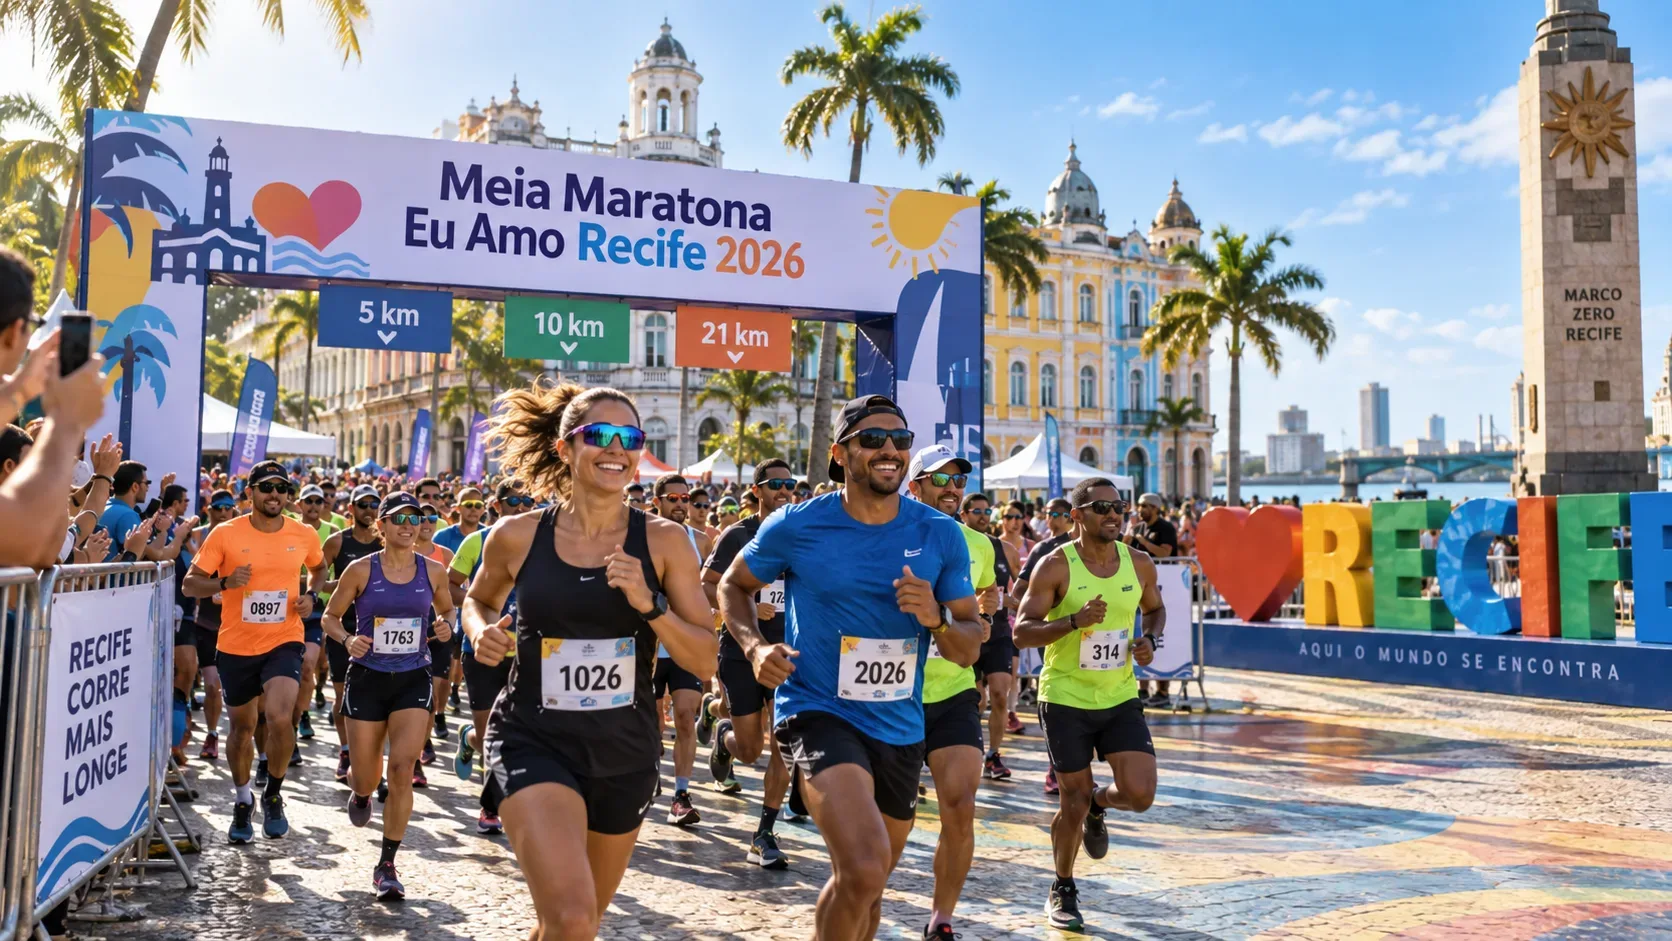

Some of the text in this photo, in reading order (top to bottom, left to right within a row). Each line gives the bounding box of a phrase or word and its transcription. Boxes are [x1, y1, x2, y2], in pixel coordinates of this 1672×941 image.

[441, 161, 772, 232] Meia Maratona
[406, 206, 806, 279] Eu Amo Recife 2026
[1565, 288, 1623, 302] MARCO
[359, 300, 420, 326] 5 km
[534, 311, 605, 338] 10 km
[1573, 307, 1616, 321] ZERO
[702, 321, 770, 348] 21 km
[1566, 327, 1623, 341] RECIFE
[250, 601, 281, 616] 0897
[69, 627, 133, 674] RECIFE
[383, 630, 414, 645] 1763
[1092, 643, 1120, 661] 314
[1299, 641, 1620, 681] AQUI O MUNDO SE ENCONTRA
[559, 663, 622, 692] 1026
[854, 660, 907, 685] 2026
[67, 664, 131, 716] CORRE
[64, 709, 114, 761] MAIS
[62, 741, 128, 806] LONGE
